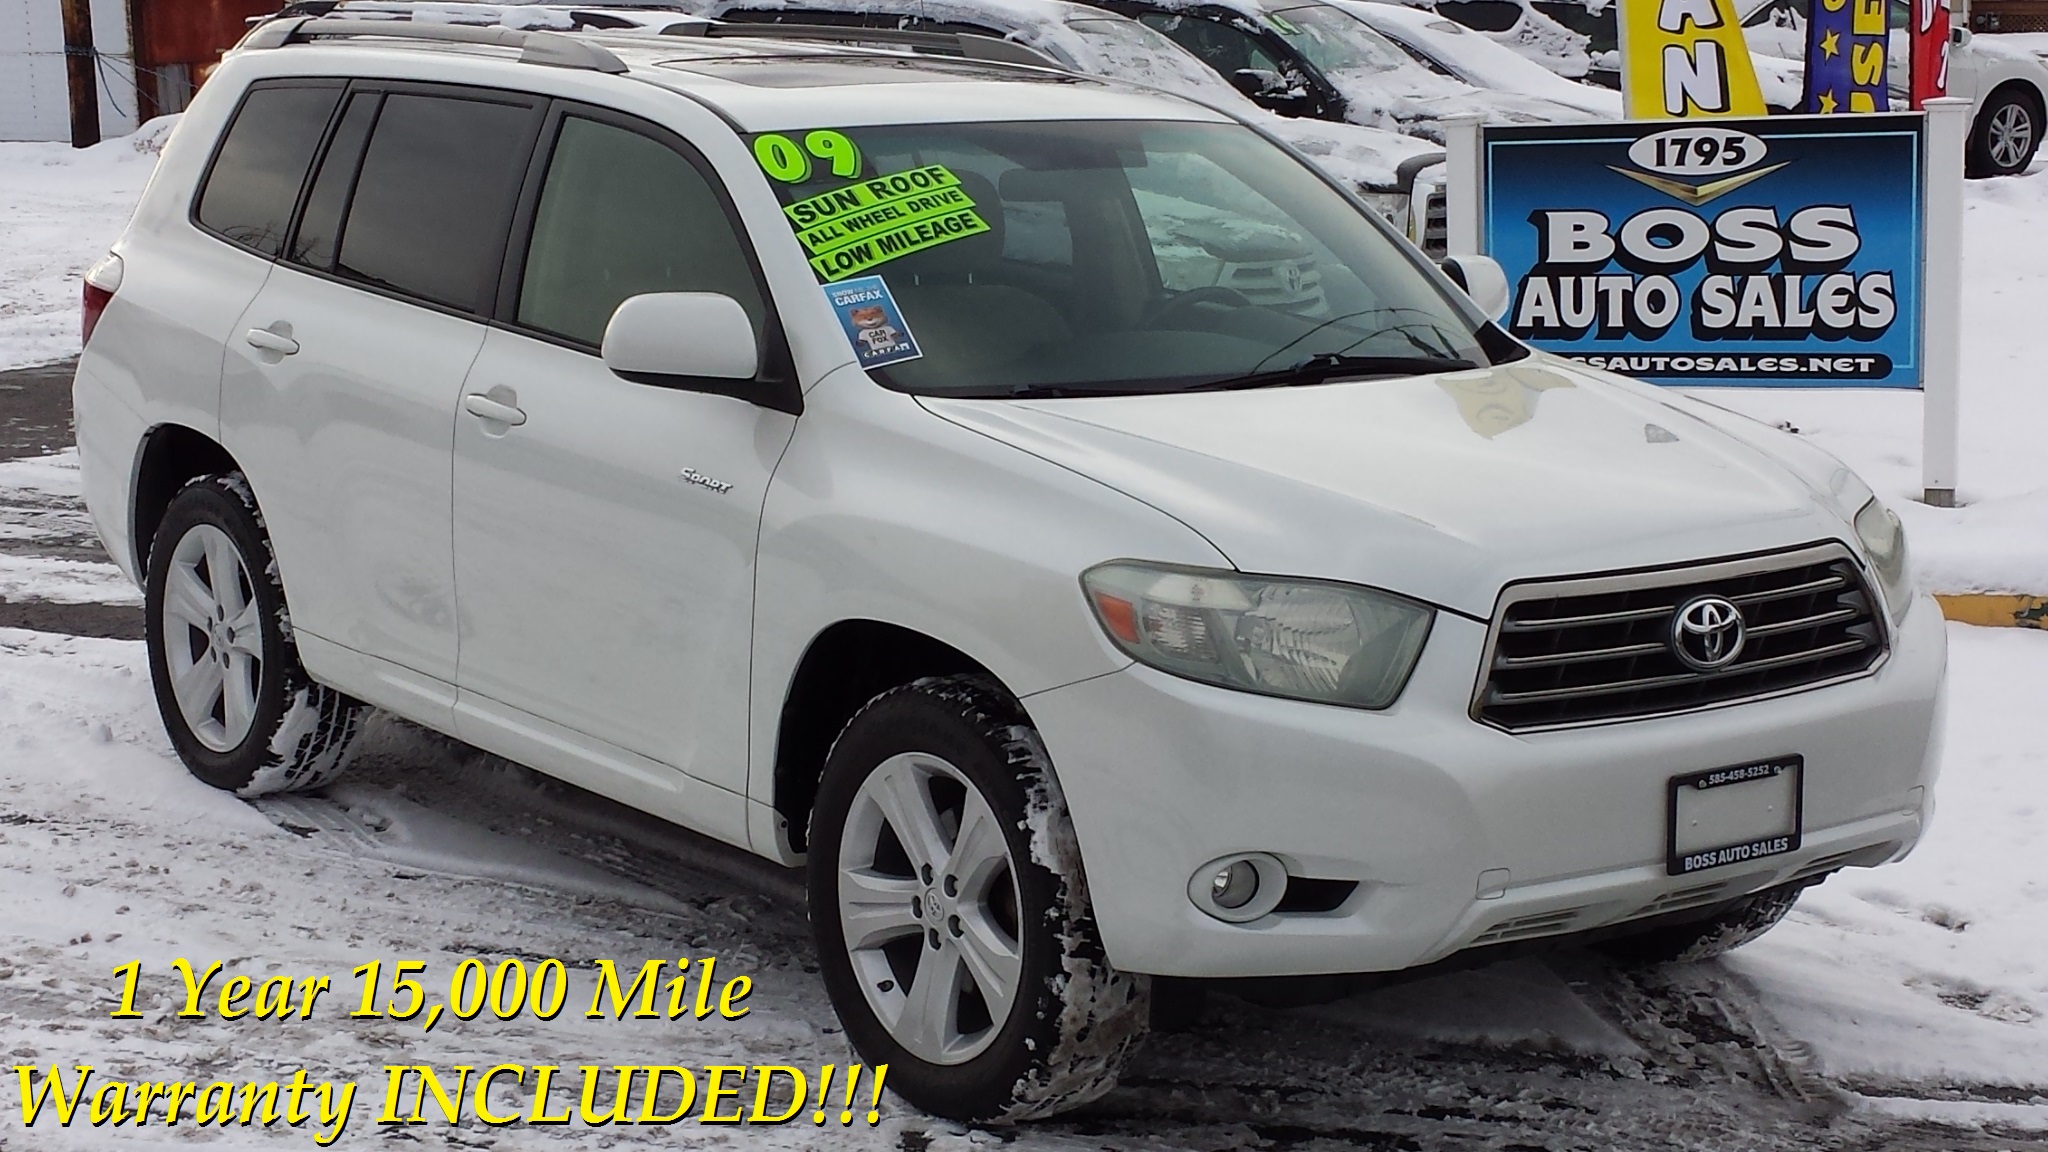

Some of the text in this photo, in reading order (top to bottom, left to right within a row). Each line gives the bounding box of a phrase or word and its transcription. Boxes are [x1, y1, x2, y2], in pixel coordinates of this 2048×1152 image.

[753, 130, 861, 183] 09
[1654, 136, 1747, 167] 1795
[793, 167, 947, 224] SUN ROOF
[806, 189, 965, 248] ALL WHEEL DRIVE
[819, 212, 979, 277] LOW MILEAGE
[1541, 205, 1862, 267] BOSS
[835, 289, 883, 306] CARFAX
[1514, 270, 1897, 331] AUTO SALES
[1708, 764, 1770, 785] 585-458-5252
[1684, 837, 1788, 872] BOSS AUTO SALES
